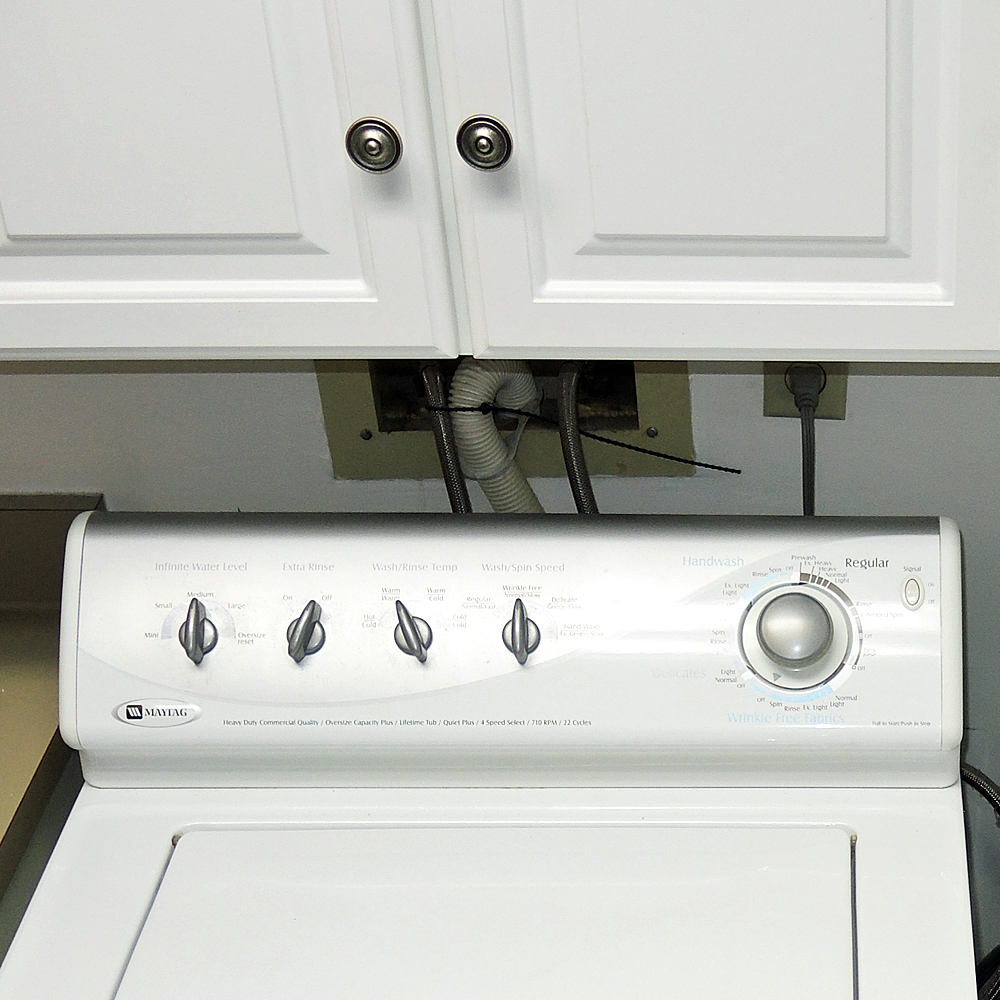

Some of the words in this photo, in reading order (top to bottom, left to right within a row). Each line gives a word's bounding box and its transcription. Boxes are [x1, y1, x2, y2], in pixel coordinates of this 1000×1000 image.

[682, 556, 744, 567] Handwash
[845, 557, 890, 570] Regular
[155, 562, 190, 572] Infinite
[192, 562, 220, 572] Water
[222, 562, 248, 572] Level
[282, 562, 306, 572] Extra
[308, 562, 335, 572] Rinse
[372, 563, 429, 572] Wash/Rinse
[431, 563, 458, 573] Temp
[481, 563, 532, 573] Wash/Spin
[535, 563, 565, 573] Speed
[228, 602, 246, 610] Large
[652, 667, 707, 679] Delicates
[144, 708, 188, 717] MAYTAG
[223, 719, 242, 727] Heavy
[243, 719, 258, 727] Duty
[259, 719, 296, 727] Commercial
[297, 719, 320, 727] Quality
[325, 719, 352, 727] Oversize
[353, 719, 379, 727] Capacity
[381, 719, 394, 727] Plus
[399, 719, 424, 727] Lifetime
[426, 719, 437, 727] Tub
[443, 719, 461, 727] Quiet
[462, 719, 475, 727] Plus
[480, 719, 485, 727] 4
[486, 719, 506, 727] Speed
[506, 719, 525, 727] Select
[531, 719, 542, 727] 710
[543, 719, 558, 727] RPM
[563, 719, 571, 727] 22
[572, 719, 592, 727] Cycles
[727, 712, 773, 724] Wrinkle
[776, 713, 801, 723] Free
[804, 713, 845, 724] Fabrics
